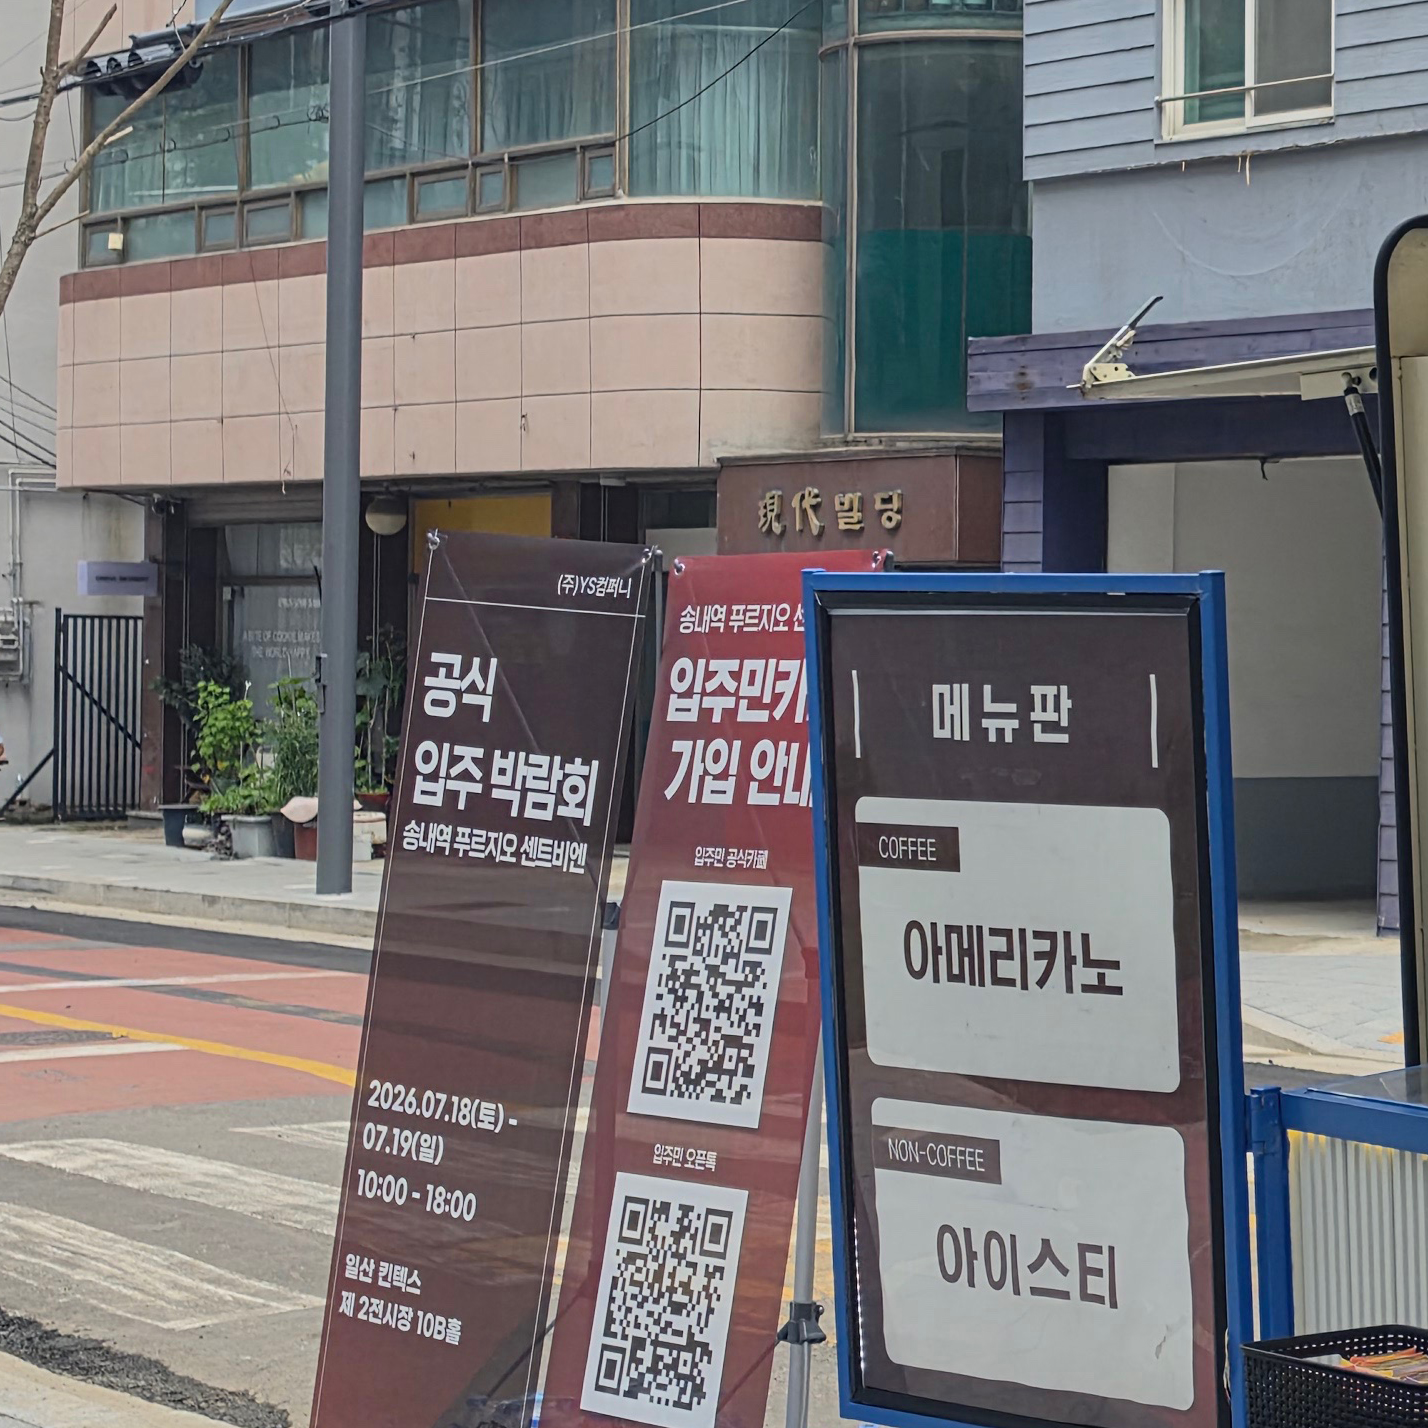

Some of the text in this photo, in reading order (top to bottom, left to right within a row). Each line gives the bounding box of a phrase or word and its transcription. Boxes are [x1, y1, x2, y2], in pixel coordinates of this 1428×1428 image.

[758, 486, 903, 537] 現代빌딩
[558, 574, 631, 598] (주)YS컴퍼니
[680, 605, 726, 633] 송내역
[729, 603, 790, 633] 푸르지오
[424, 652, 497, 722] 공식
[666, 657, 809, 724] 입주민카
[933, 684, 1072, 743] 메뉴판
[413, 741, 599, 826] 입주 박람회
[664, 738, 812, 807] 가입 안내
[403, 820, 587, 874] 송내역 푸르지오 센트비엔
[695, 847, 768, 869] 입주민 공식카페
[879, 836, 936, 860] COFFEE
[904, 920, 1123, 995] 아메리카노
[367, 1078, 505, 1134] 2026.07.18(토)
[363, 1122, 443, 1165] 07.19(일)
[653, 1144, 717, 1171] 입주민 오픈톡
[888, 1138, 985, 1171] NON-COFFEE
[358, 1169, 407, 1205] 10:00
[426, 1184, 476, 1221] 18:00
[345, 1254, 421, 1294] 일산 킨텍스
[937, 1224, 1118, 1309] 아이스티
[339, 1291, 461, 1345] 제 2전시장 10B홀
